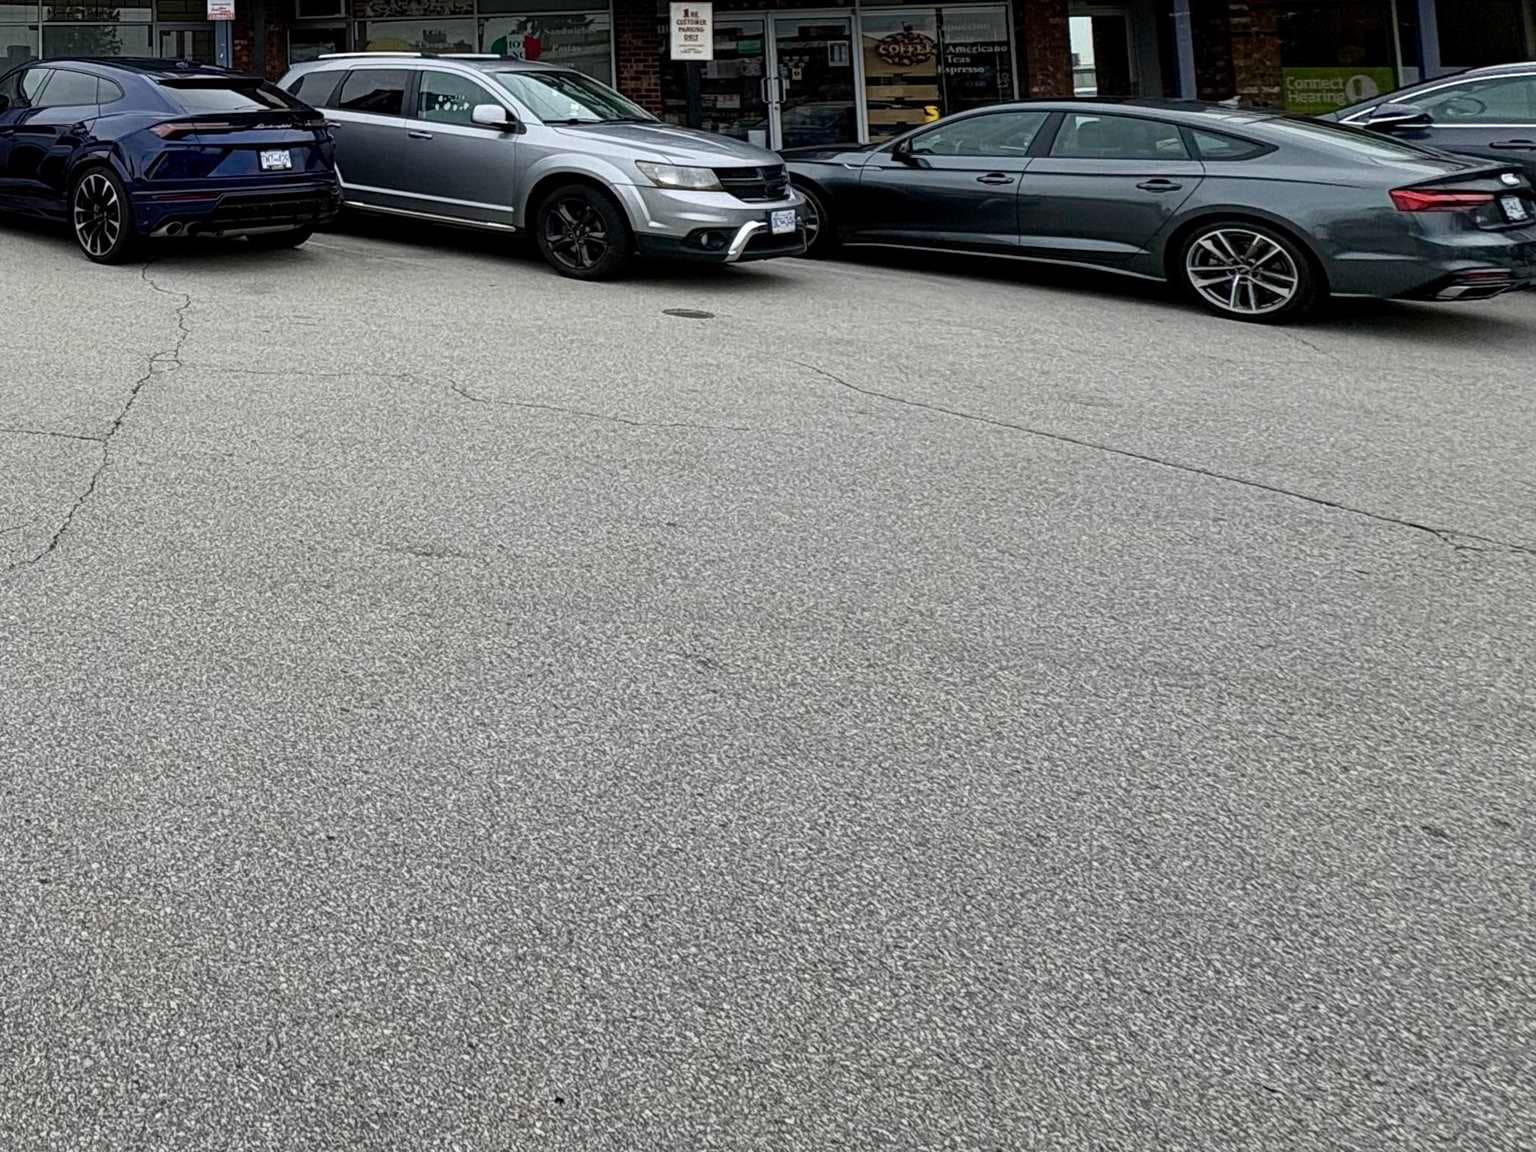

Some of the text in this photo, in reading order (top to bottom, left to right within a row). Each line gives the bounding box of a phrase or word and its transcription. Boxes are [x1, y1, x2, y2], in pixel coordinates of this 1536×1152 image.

[945, 43, 1008, 54] Americano
[1286, 76, 1344, 90] Connect
[1288, 90, 1345, 106] Hearing
